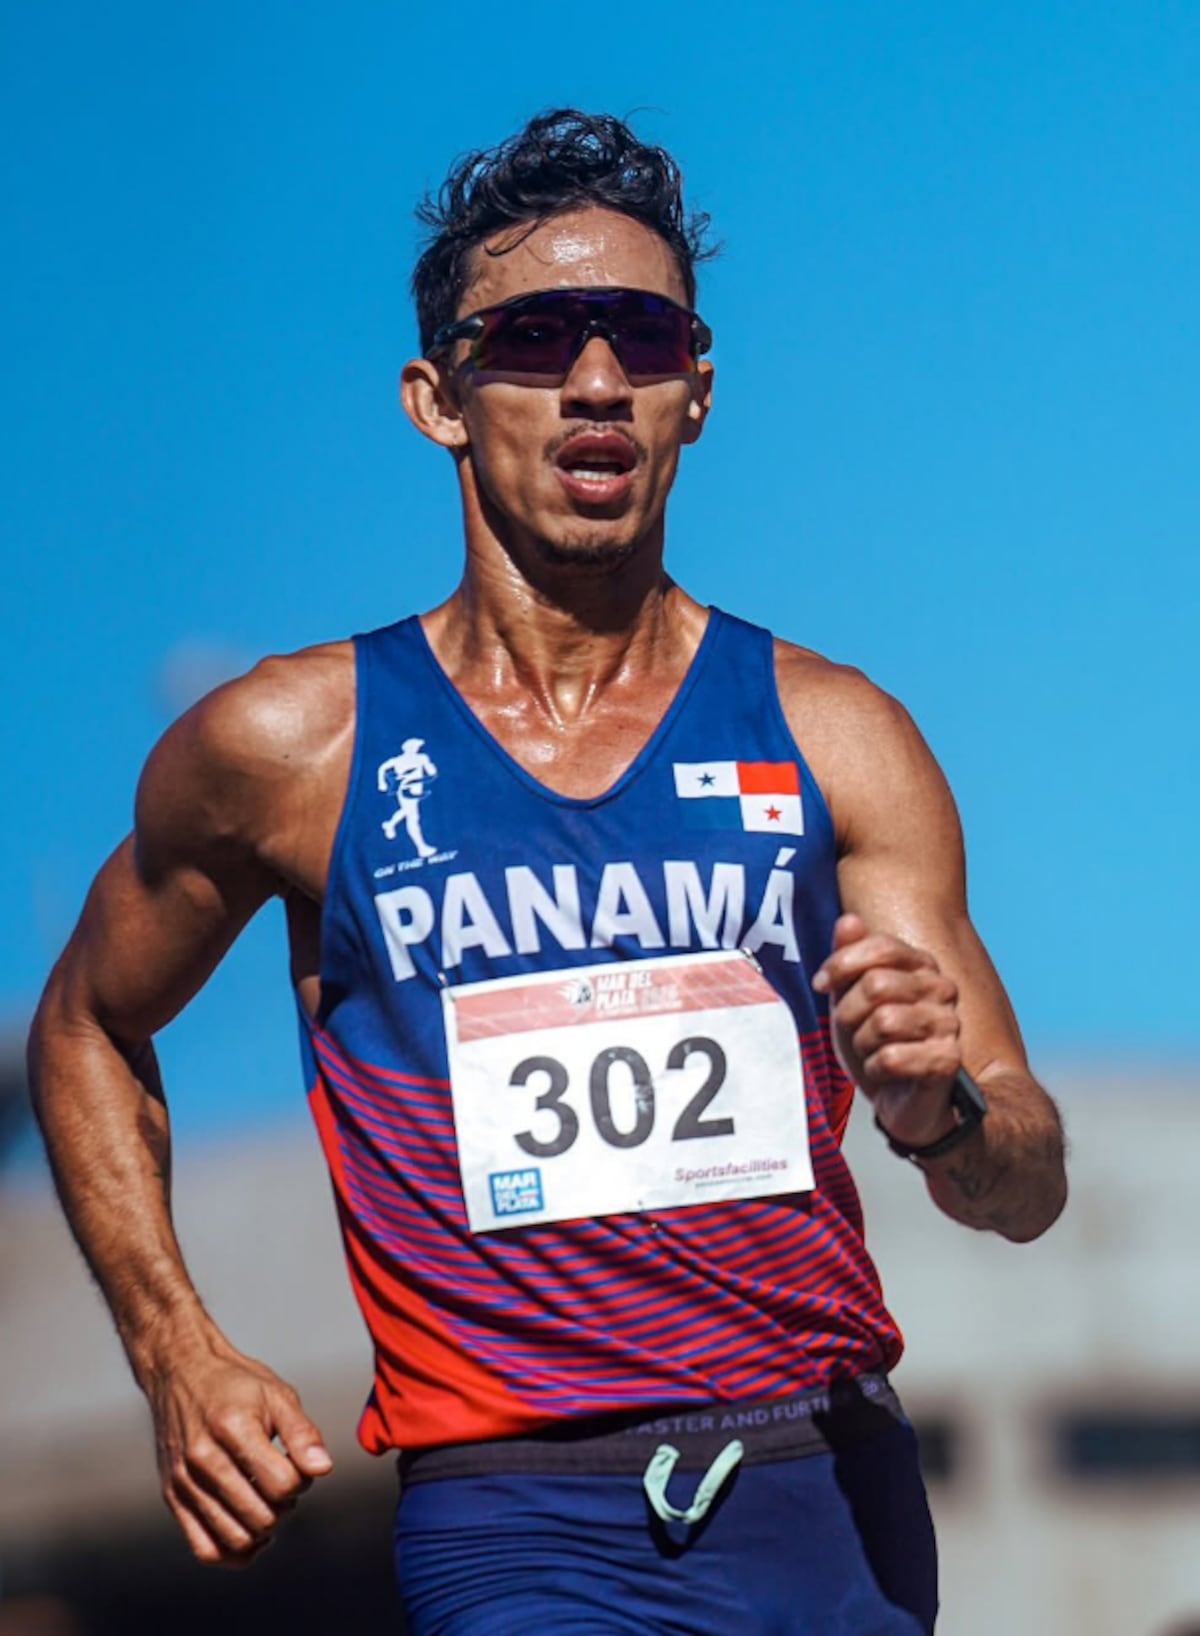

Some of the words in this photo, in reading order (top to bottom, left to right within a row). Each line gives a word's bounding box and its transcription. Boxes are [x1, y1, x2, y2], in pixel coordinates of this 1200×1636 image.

[374, 847, 800, 982] PANAMÁ
[508, 1036, 735, 1158] 302
[494, 1171, 537, 1188] MAR
[674, 1159, 788, 1184] Sportsfacilities
[626, 1414, 714, 1435] ASTER
[721, 1408, 769, 1429] AND
